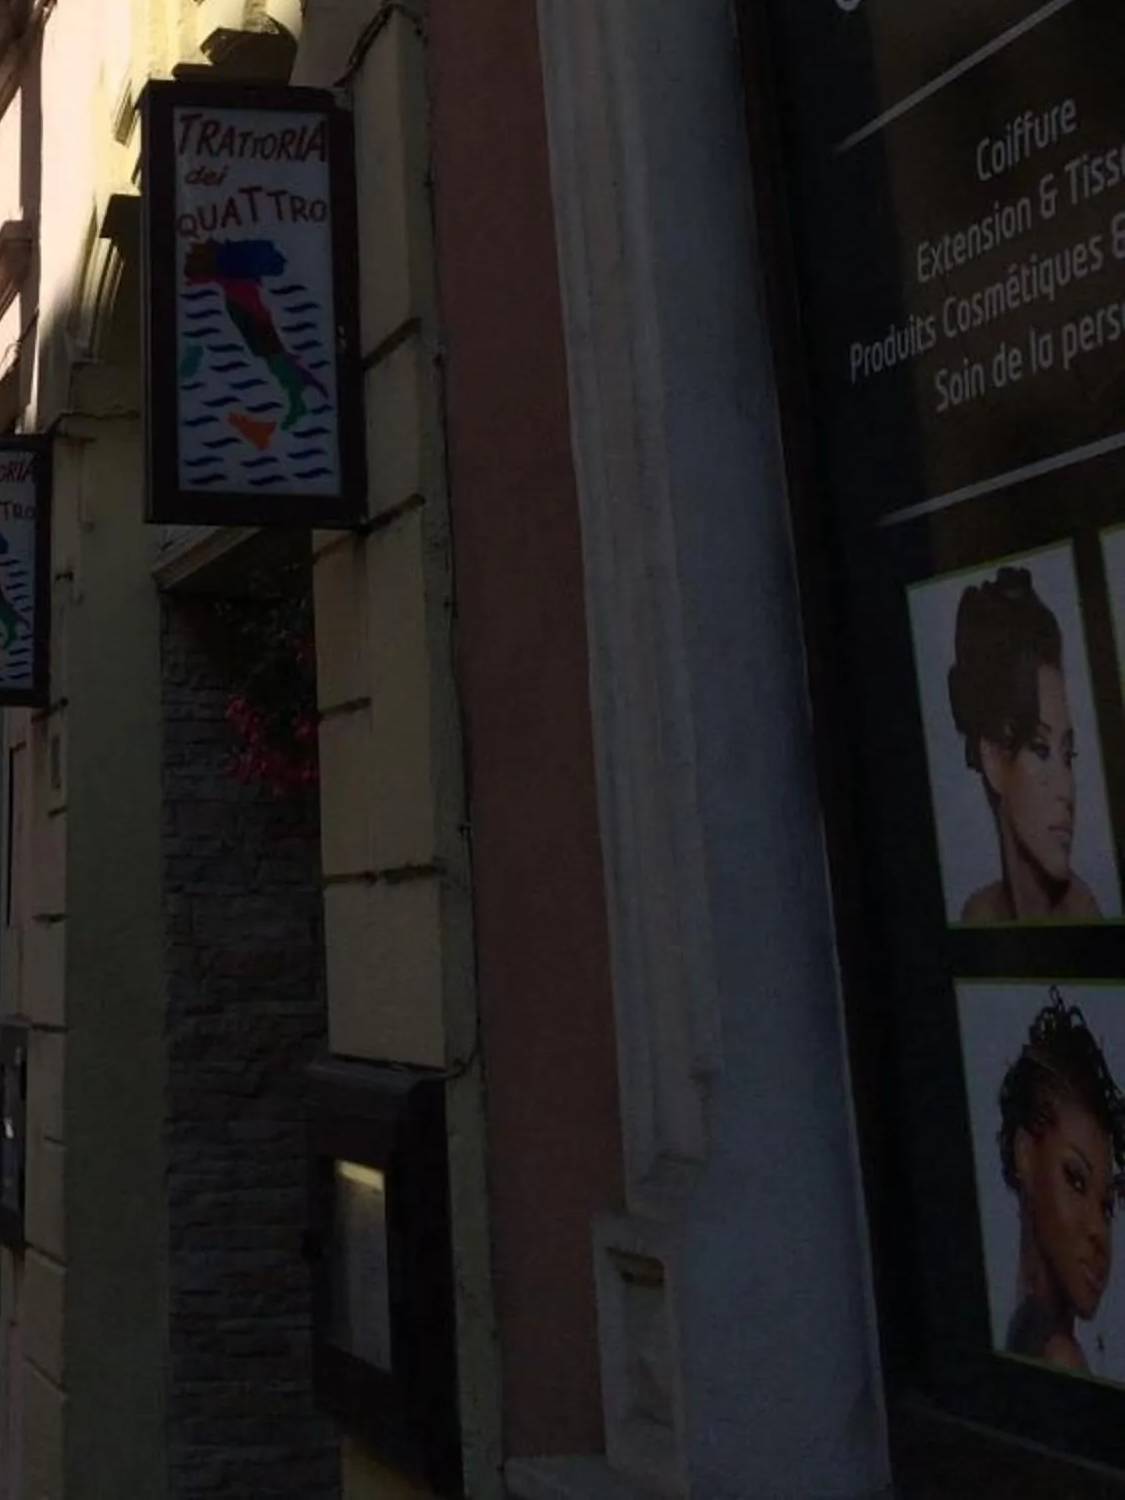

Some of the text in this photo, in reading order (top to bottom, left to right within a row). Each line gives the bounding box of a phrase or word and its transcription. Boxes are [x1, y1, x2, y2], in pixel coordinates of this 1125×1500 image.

[179, 113, 325, 162] TRATTORIA
[185, 165, 229, 185] dei
[976, 98, 1077, 181] Coiffure
[177, 186, 326, 239] QUATTRO
[917, 145, 1125, 284] Extension & Tiss
[849, 314, 936, 383] Produits
[943, 235, 1104, 338] Cosmétiques
[935, 301, 1125, 413] Soin de la pers
